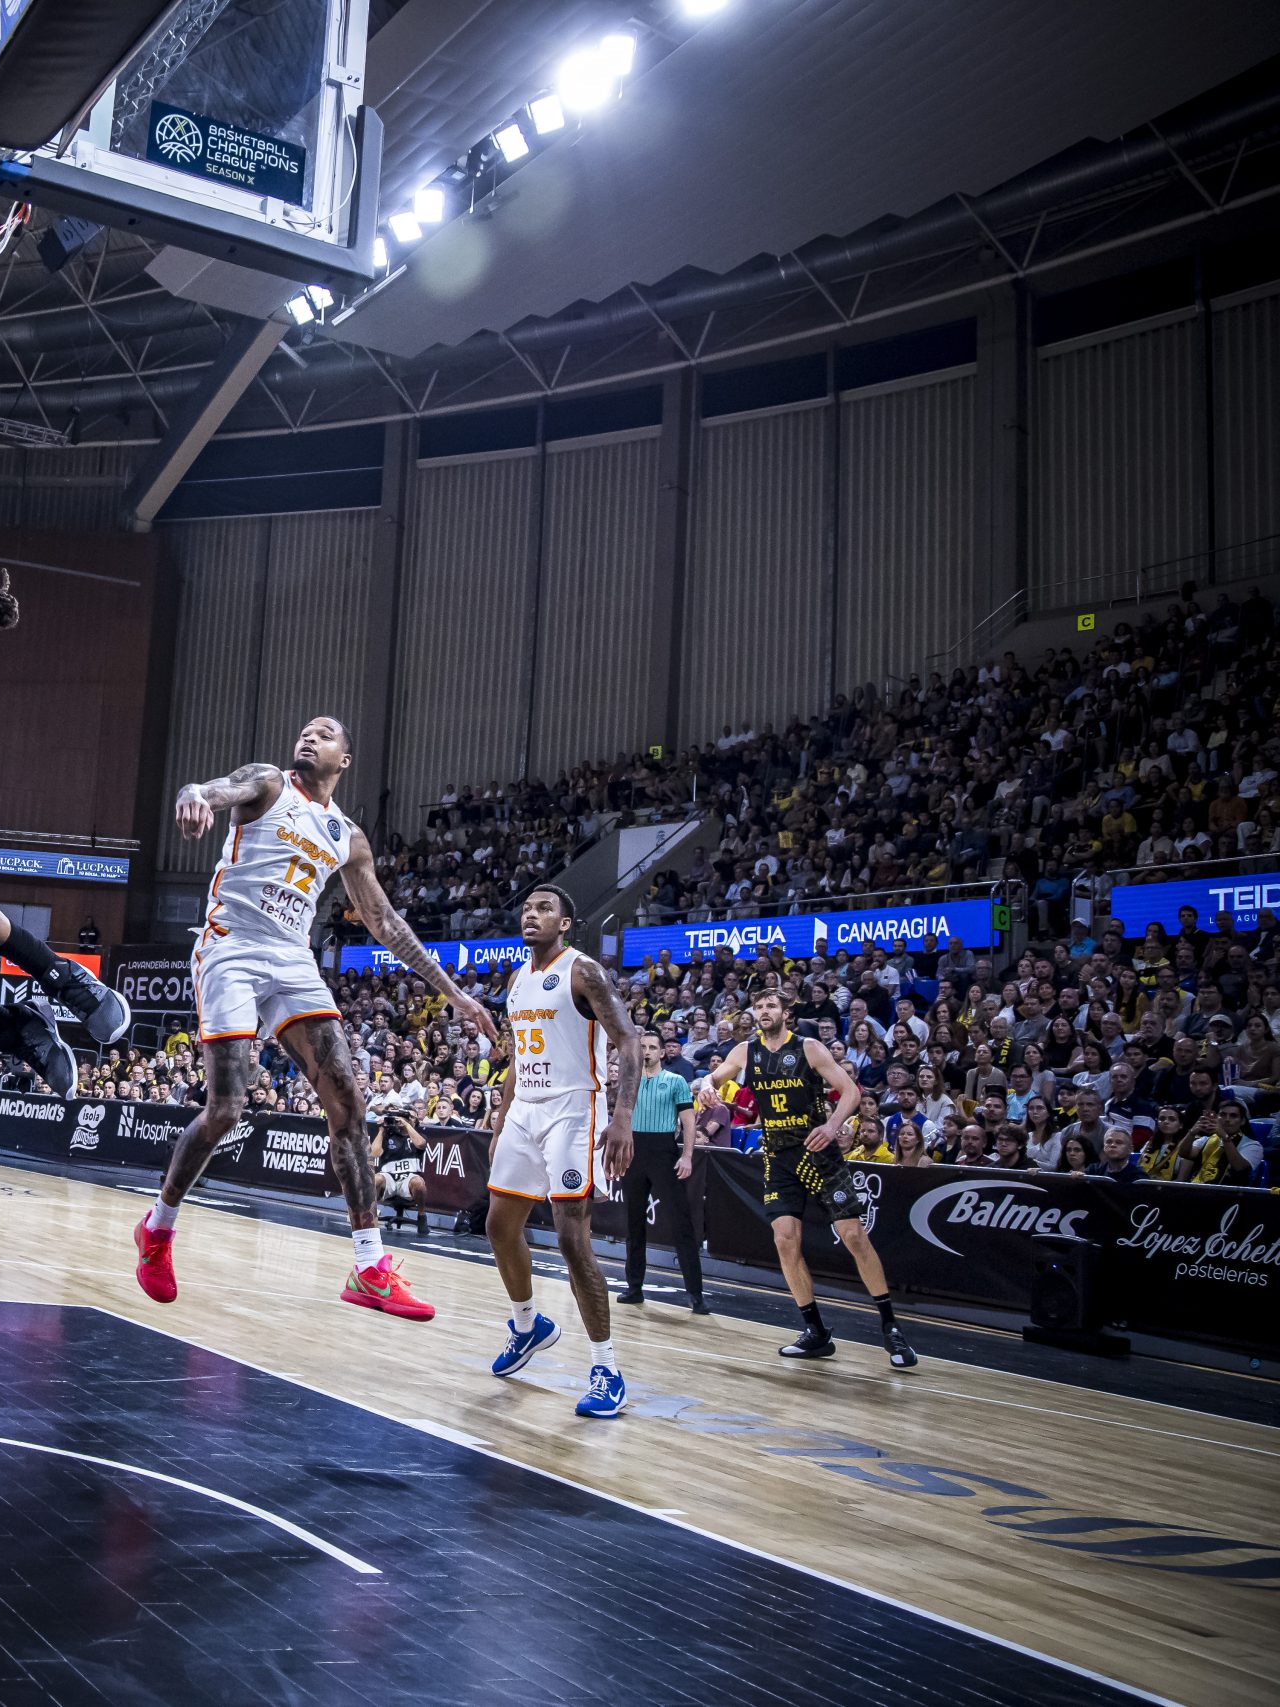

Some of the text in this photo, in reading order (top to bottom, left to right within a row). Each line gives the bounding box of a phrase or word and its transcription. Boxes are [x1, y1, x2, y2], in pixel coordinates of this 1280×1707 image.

[208, 125, 290, 158] BASKETBALL
[206, 149, 256, 172] LEAGUE
[207, 137, 299, 174] CHAMPIONS
[206, 163, 255, 185] SEASON X
[1082, 617, 1091, 627] C
[284, 855, 317, 894] 12
[998, 910, 1007, 926] C
[685, 915, 950, 957] TEIDAGUA CANARAGUA
[128, 959, 169, 970] LAVANDERÍA
[516, 1029, 545, 1054] 35
[522, 1062, 551, 1075] MCT
[764, 1079, 803, 1090] LAGUNA
[0, 1099, 65, 1122] McDonald's
[770, 1094, 788, 1112] 42
[83, 1109, 100, 1121] isola
[266, 1130, 330, 1155] TERRENOS
[394, 1162, 410, 1172] HB
[1117, 1204, 1201, 1259] López
[1175, 1262, 1268, 1287] pastelerías
